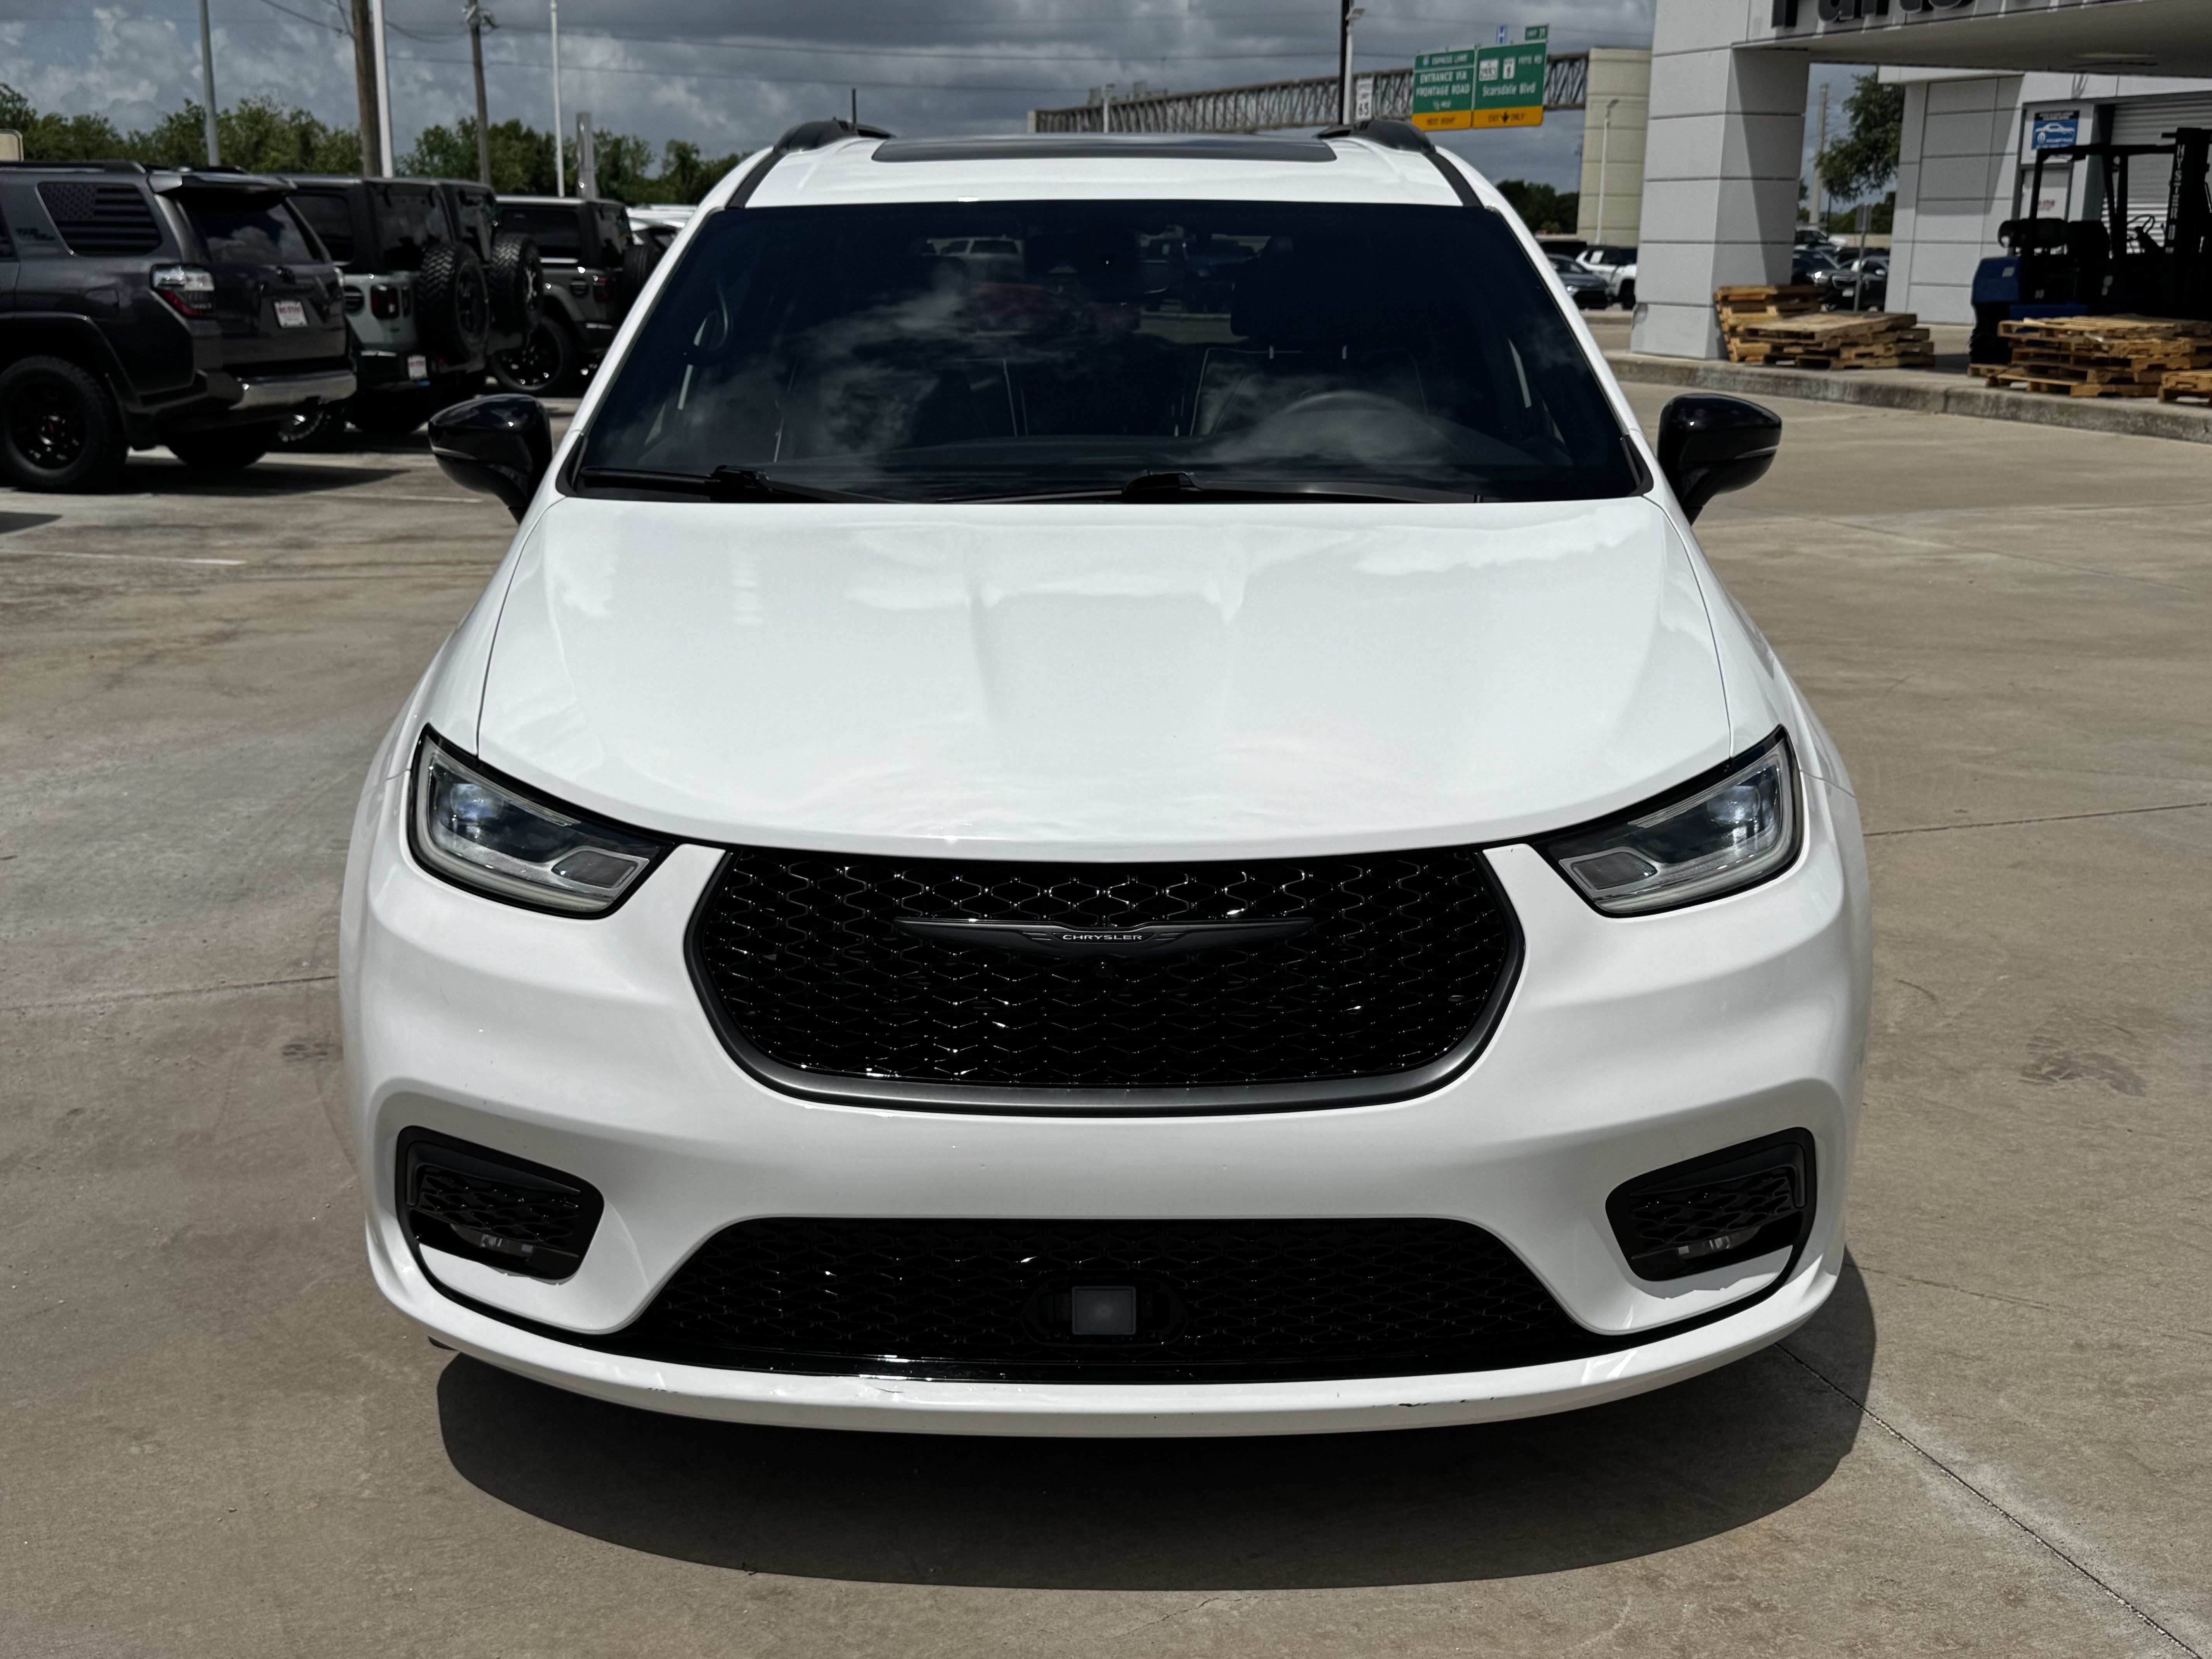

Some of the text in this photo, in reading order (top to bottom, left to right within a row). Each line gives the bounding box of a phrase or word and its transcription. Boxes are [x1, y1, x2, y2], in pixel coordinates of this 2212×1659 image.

[1420, 70, 1453, 84] ENTRANCE
[1416, 84, 1470, 97] FRONTAGE ROAD
[1482, 82, 1536, 97] Scarsdale Blvd
[1358, 101, 1369, 116] 65
